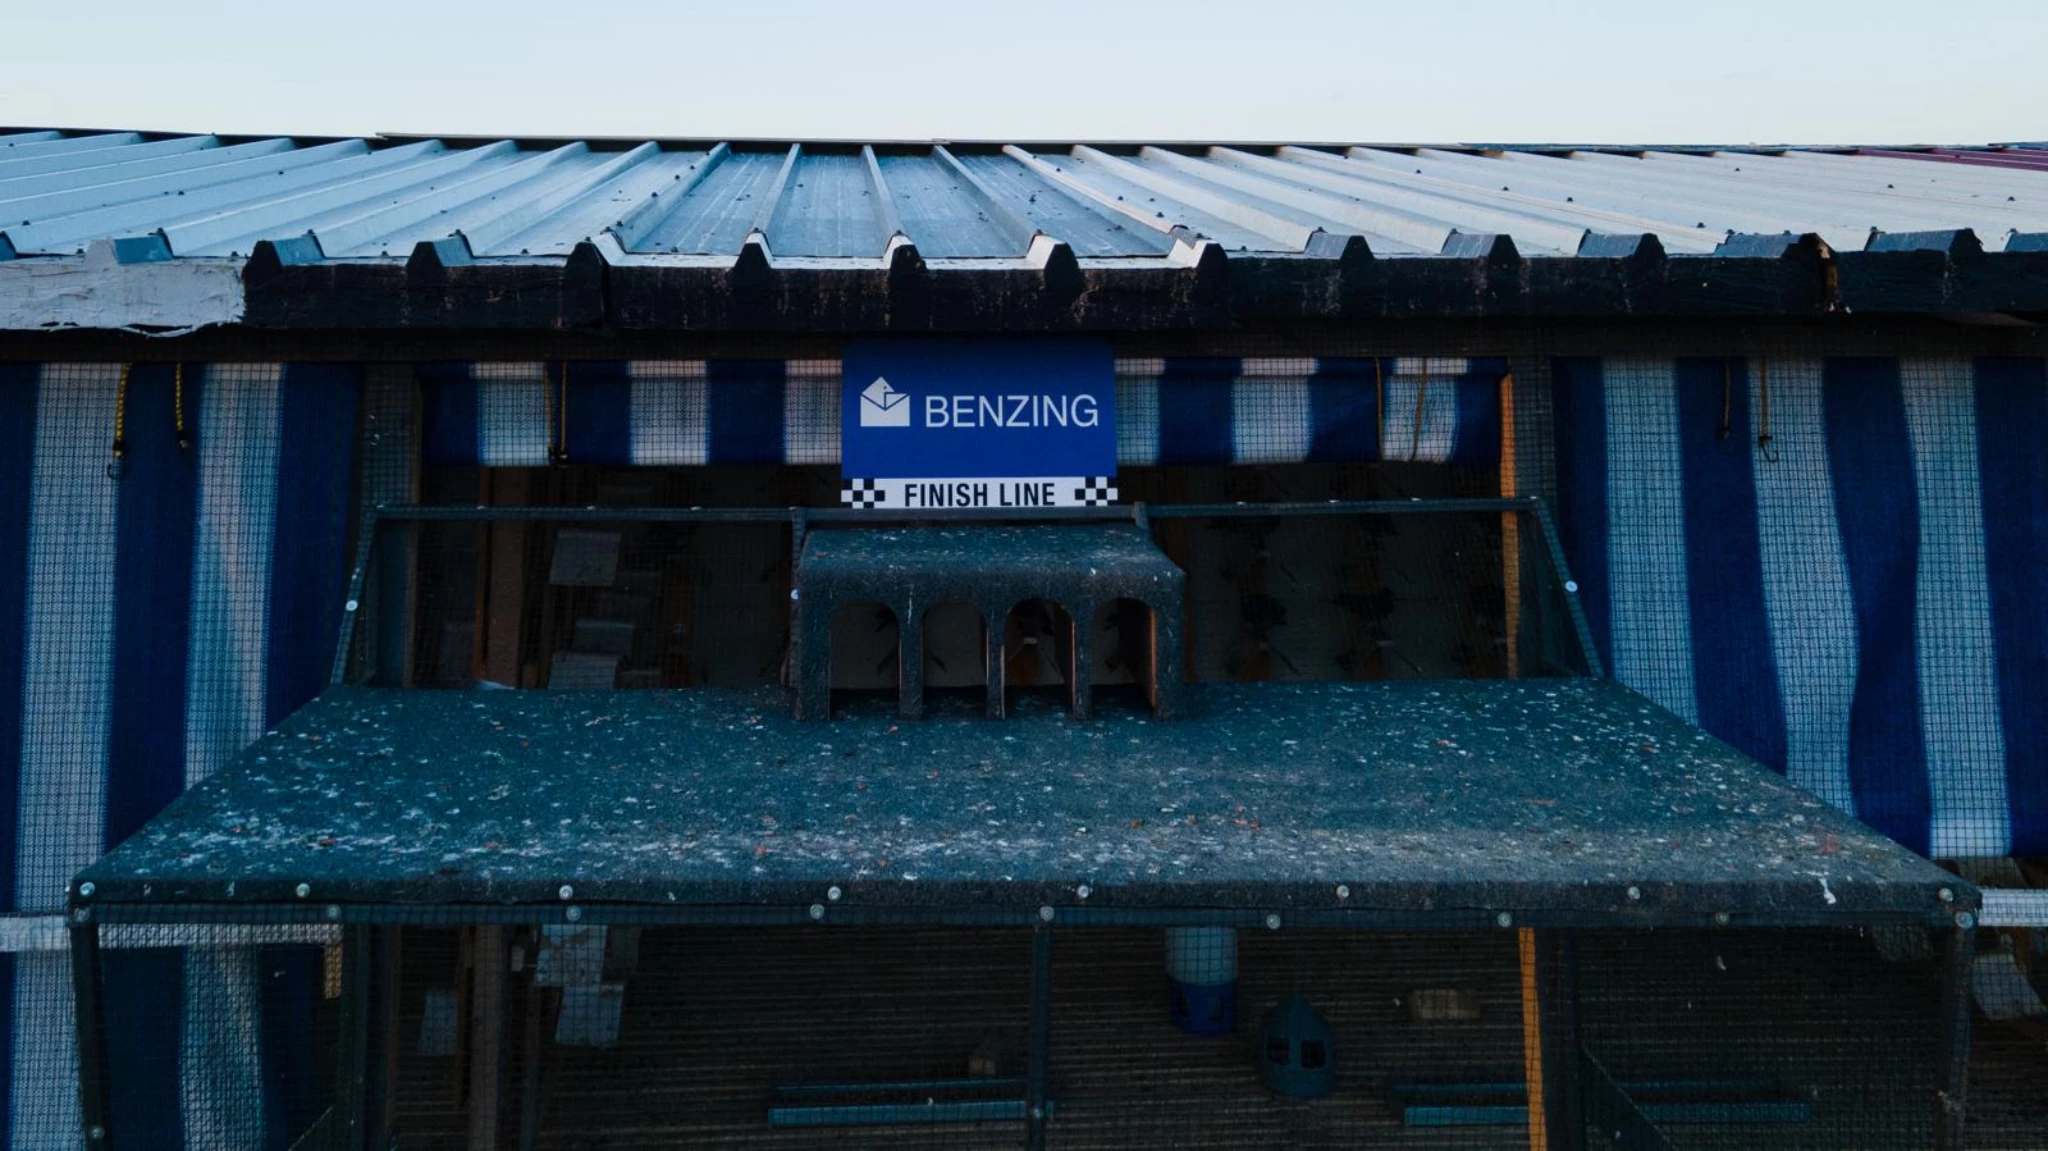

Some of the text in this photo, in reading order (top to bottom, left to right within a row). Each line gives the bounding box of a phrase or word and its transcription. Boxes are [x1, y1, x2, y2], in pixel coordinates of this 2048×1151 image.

[925, 394, 1099, 427] BENZING
[905, 483, 1055, 507] FINISH LINE
